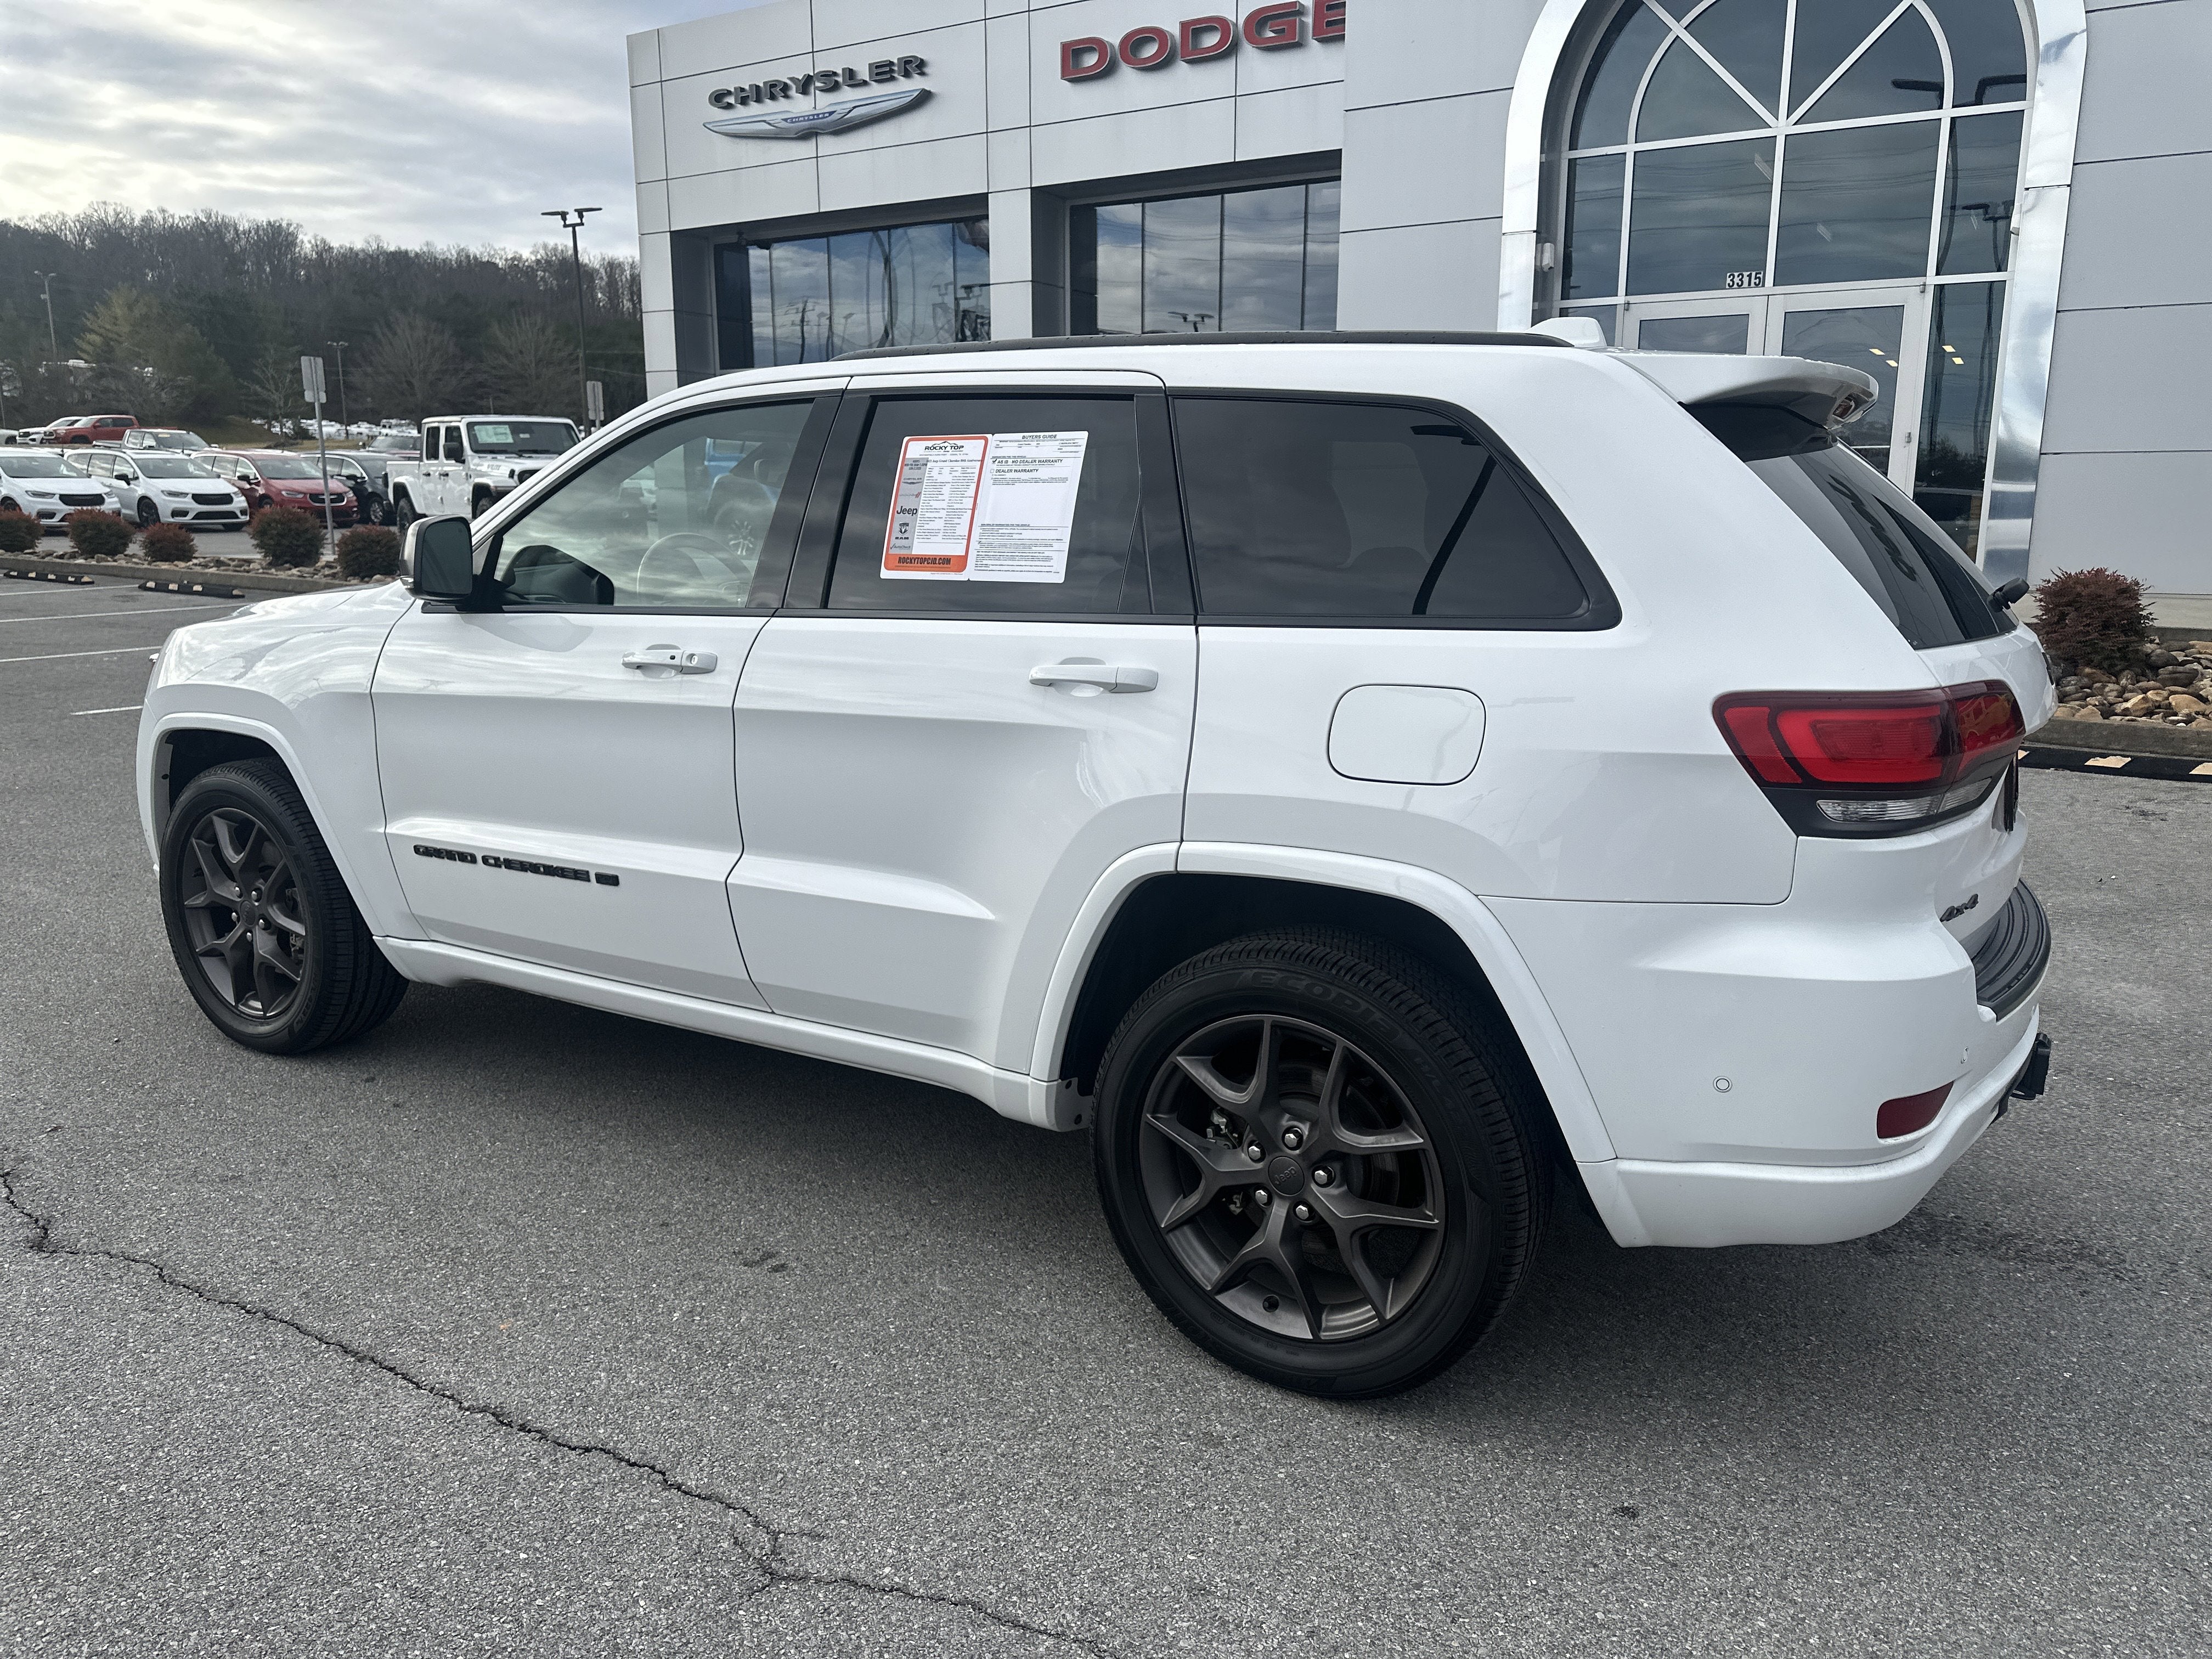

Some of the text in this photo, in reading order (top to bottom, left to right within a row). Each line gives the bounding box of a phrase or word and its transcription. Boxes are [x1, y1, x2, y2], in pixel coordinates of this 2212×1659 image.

[708, 54, 926, 108] CHRYSLER
[787, 112, 830, 122] CHRYSLER
[1727, 272, 1762, 288] 3315
[896, 506, 918, 516] Jeep
[898, 556, 951, 565] ROCKYTOPCJD.COM
[413, 844, 477, 864] GRAND
[481, 855, 591, 882] CHEROKEE
[1274, 1166, 1297, 1186] Jeep
